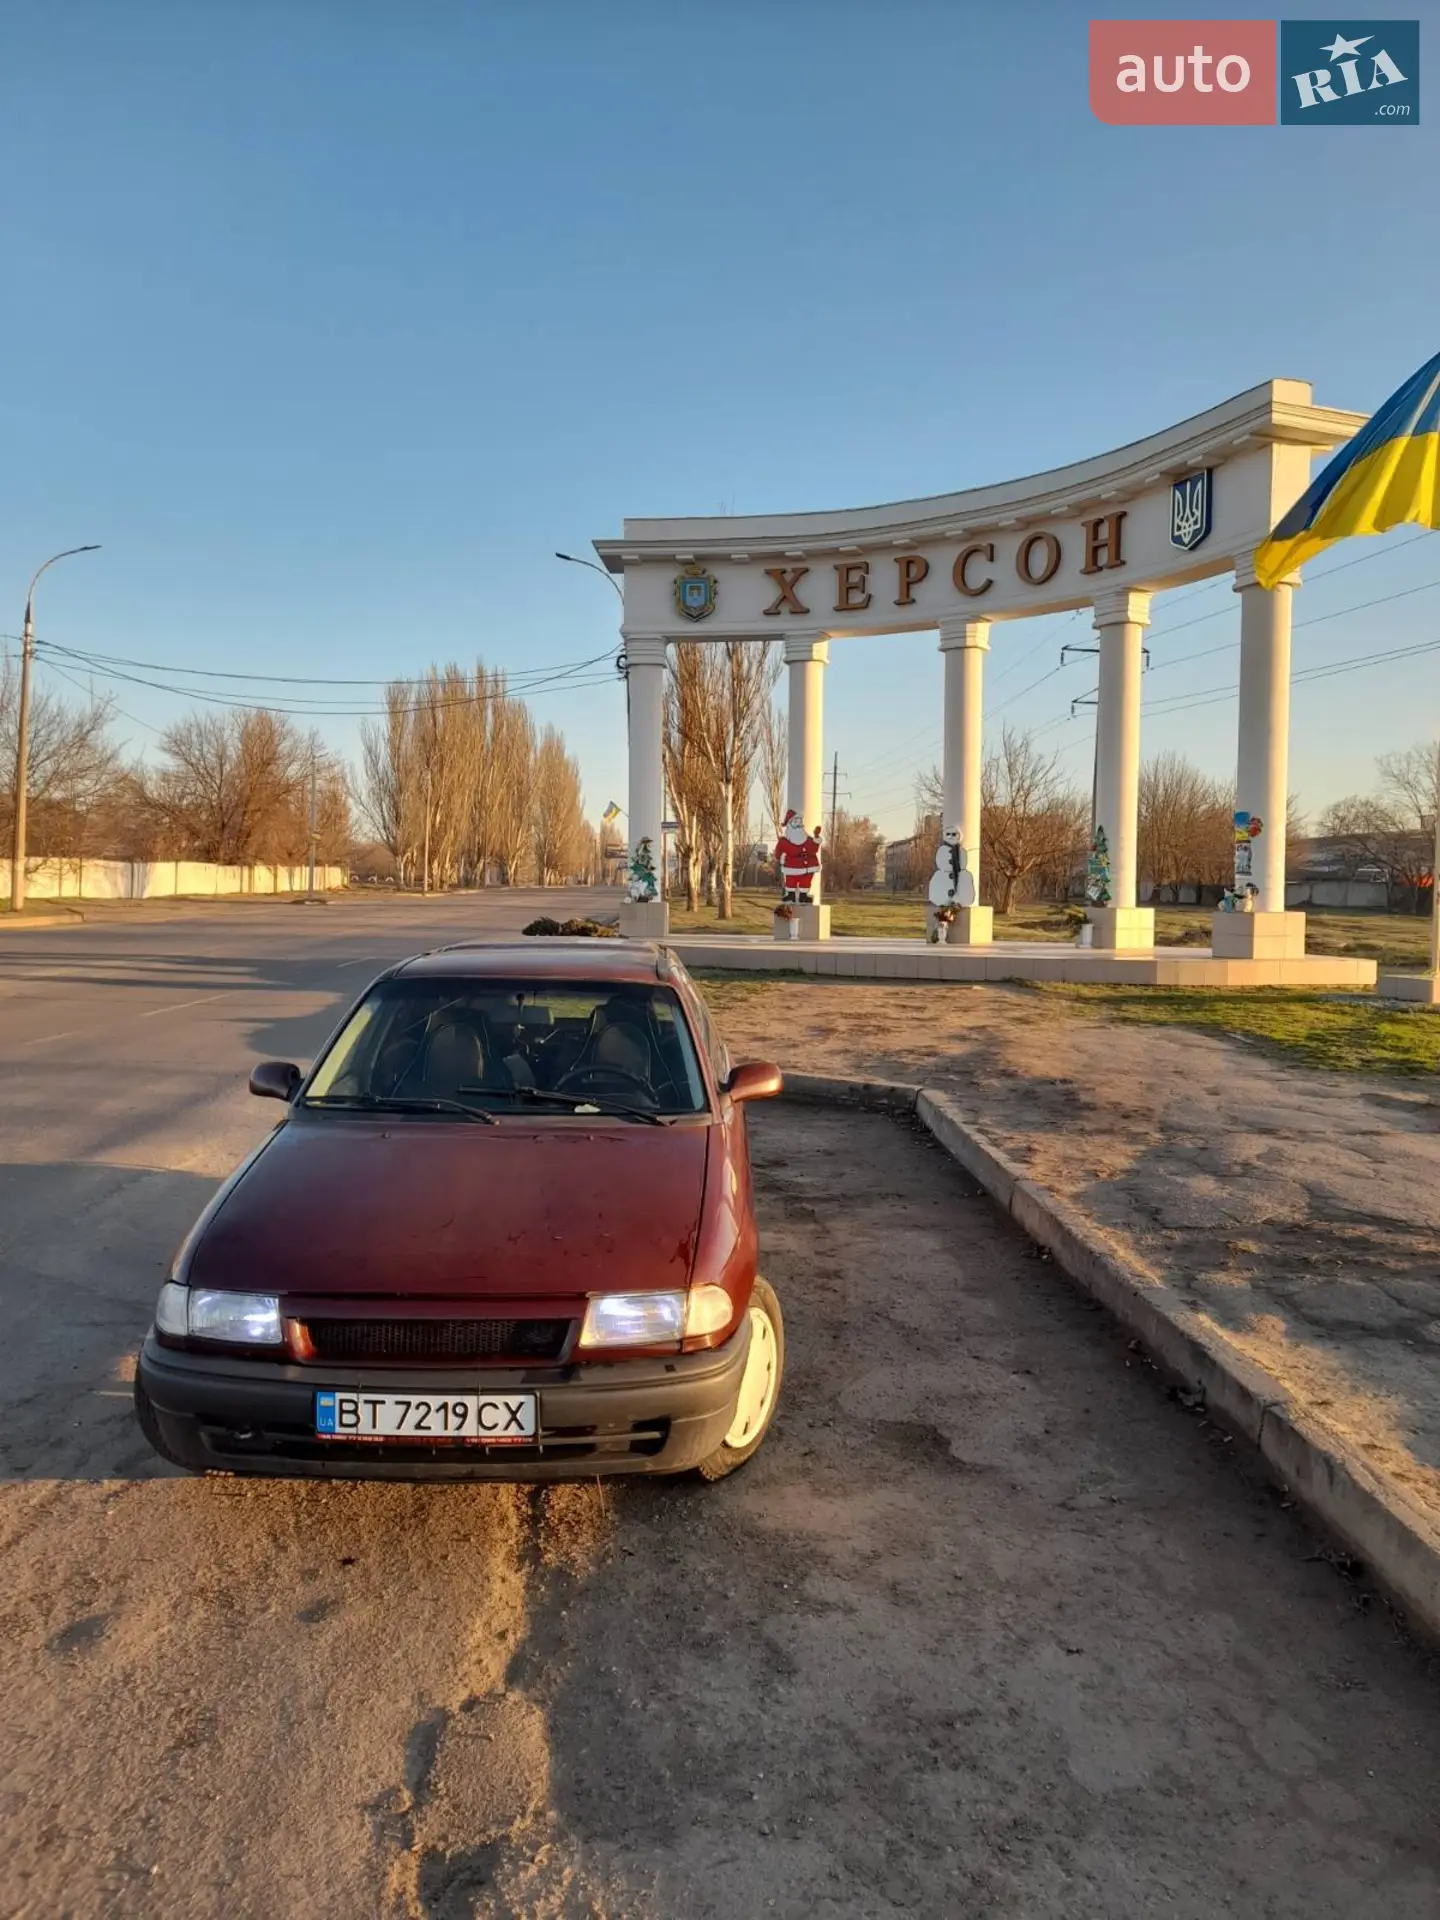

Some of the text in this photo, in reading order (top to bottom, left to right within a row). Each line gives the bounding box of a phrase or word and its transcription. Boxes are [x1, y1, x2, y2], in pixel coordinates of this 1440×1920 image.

[763, 511, 1127, 615] ХЕРСОН
[320, 1418, 334, 1427] UA
[338, 1399, 525, 1431] BT 7219 CX
